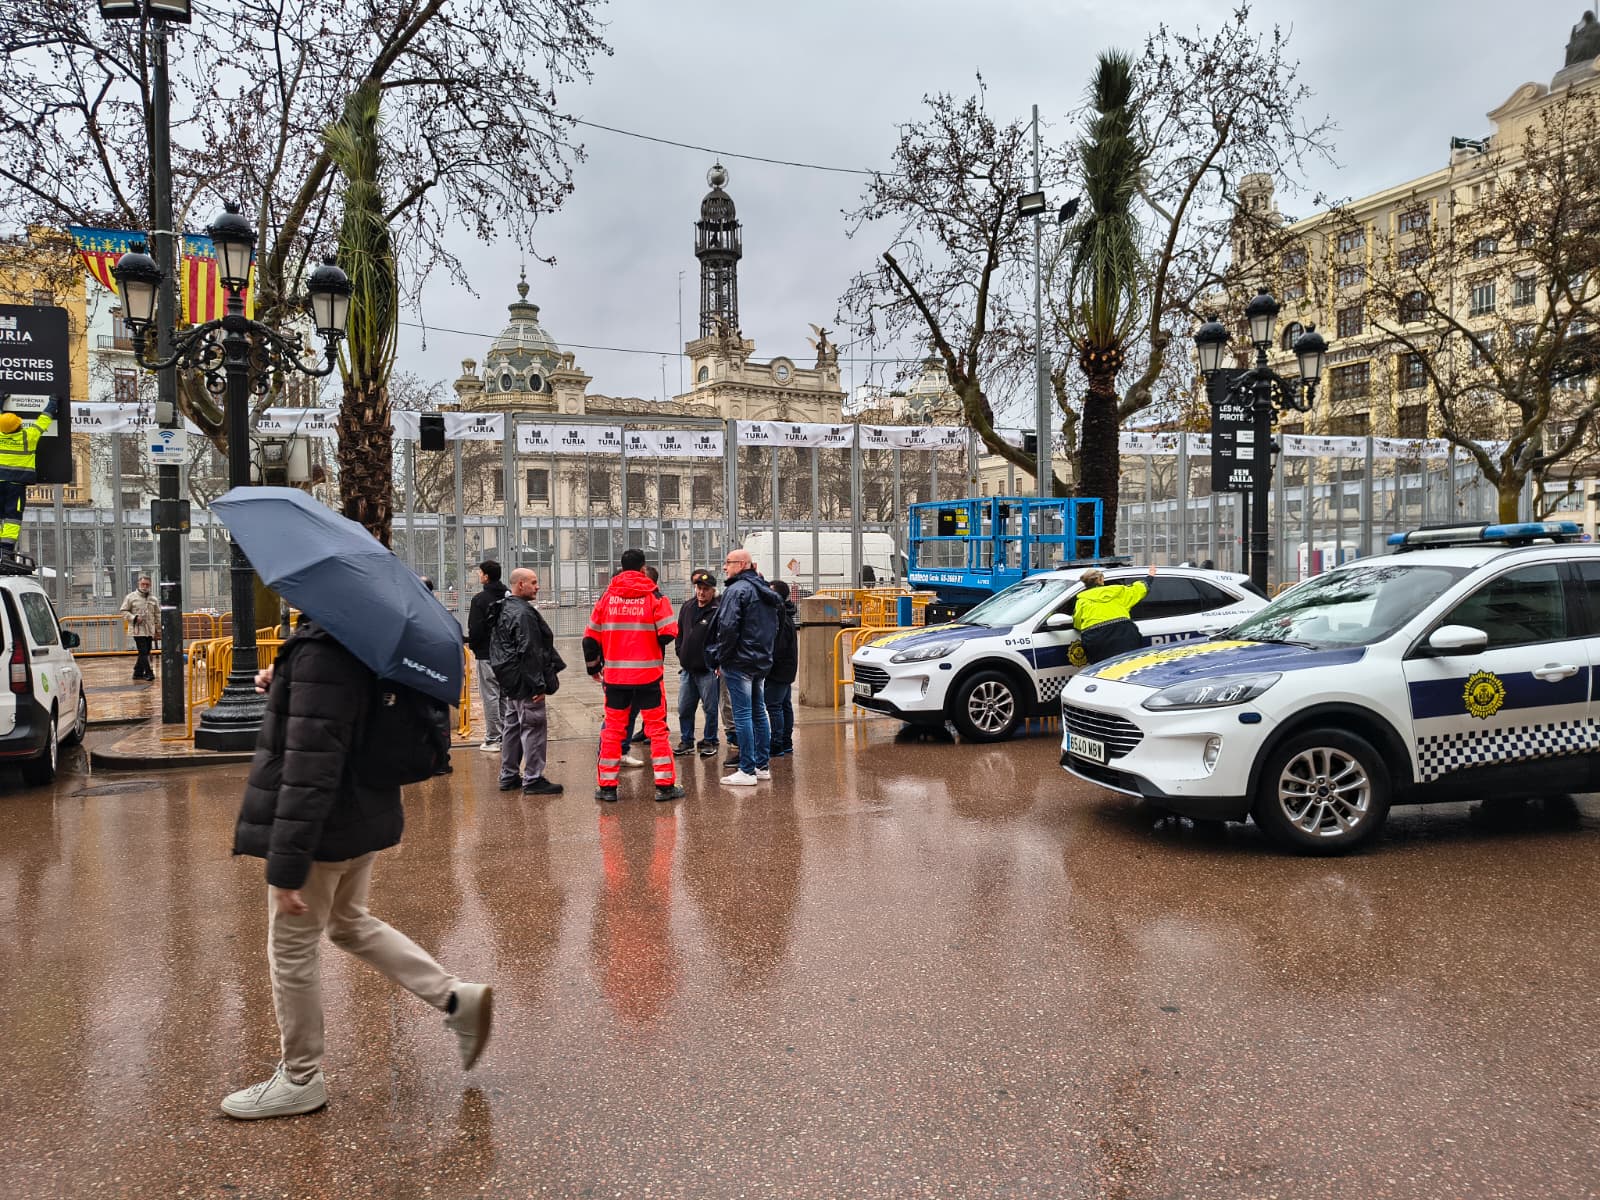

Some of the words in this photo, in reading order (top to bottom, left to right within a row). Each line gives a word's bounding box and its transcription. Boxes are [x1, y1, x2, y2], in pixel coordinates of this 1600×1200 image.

[0, 357, 54, 369] OSTRES
[525, 437, 549, 445] TURIA
[785, 433, 808, 441] TURIA
[1004, 637, 1031, 646] D1-05
